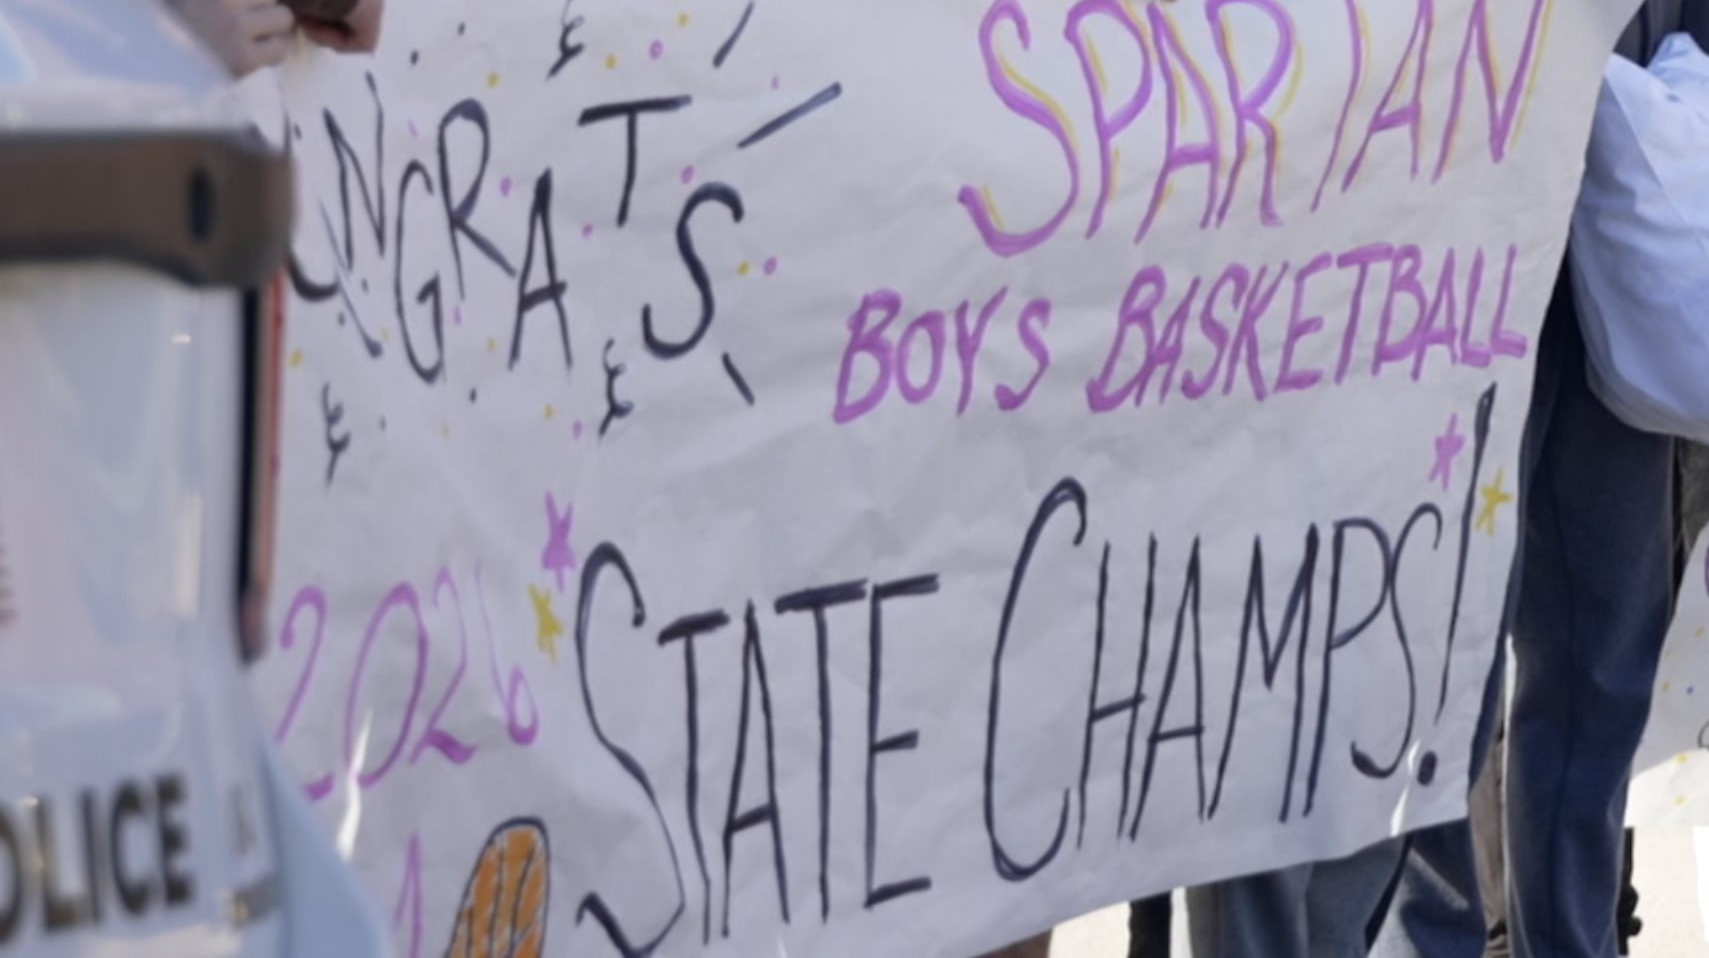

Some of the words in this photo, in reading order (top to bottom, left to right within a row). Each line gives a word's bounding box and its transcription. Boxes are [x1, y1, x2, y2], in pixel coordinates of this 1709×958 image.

[831, 287, 1052, 425] BOYS
[1085, 242, 1528, 413] BASKETBALL
[272, 557, 541, 806] 2026
[574, 541, 940, 958] STATE
[982, 381, 1498, 884] CHAMPS!
